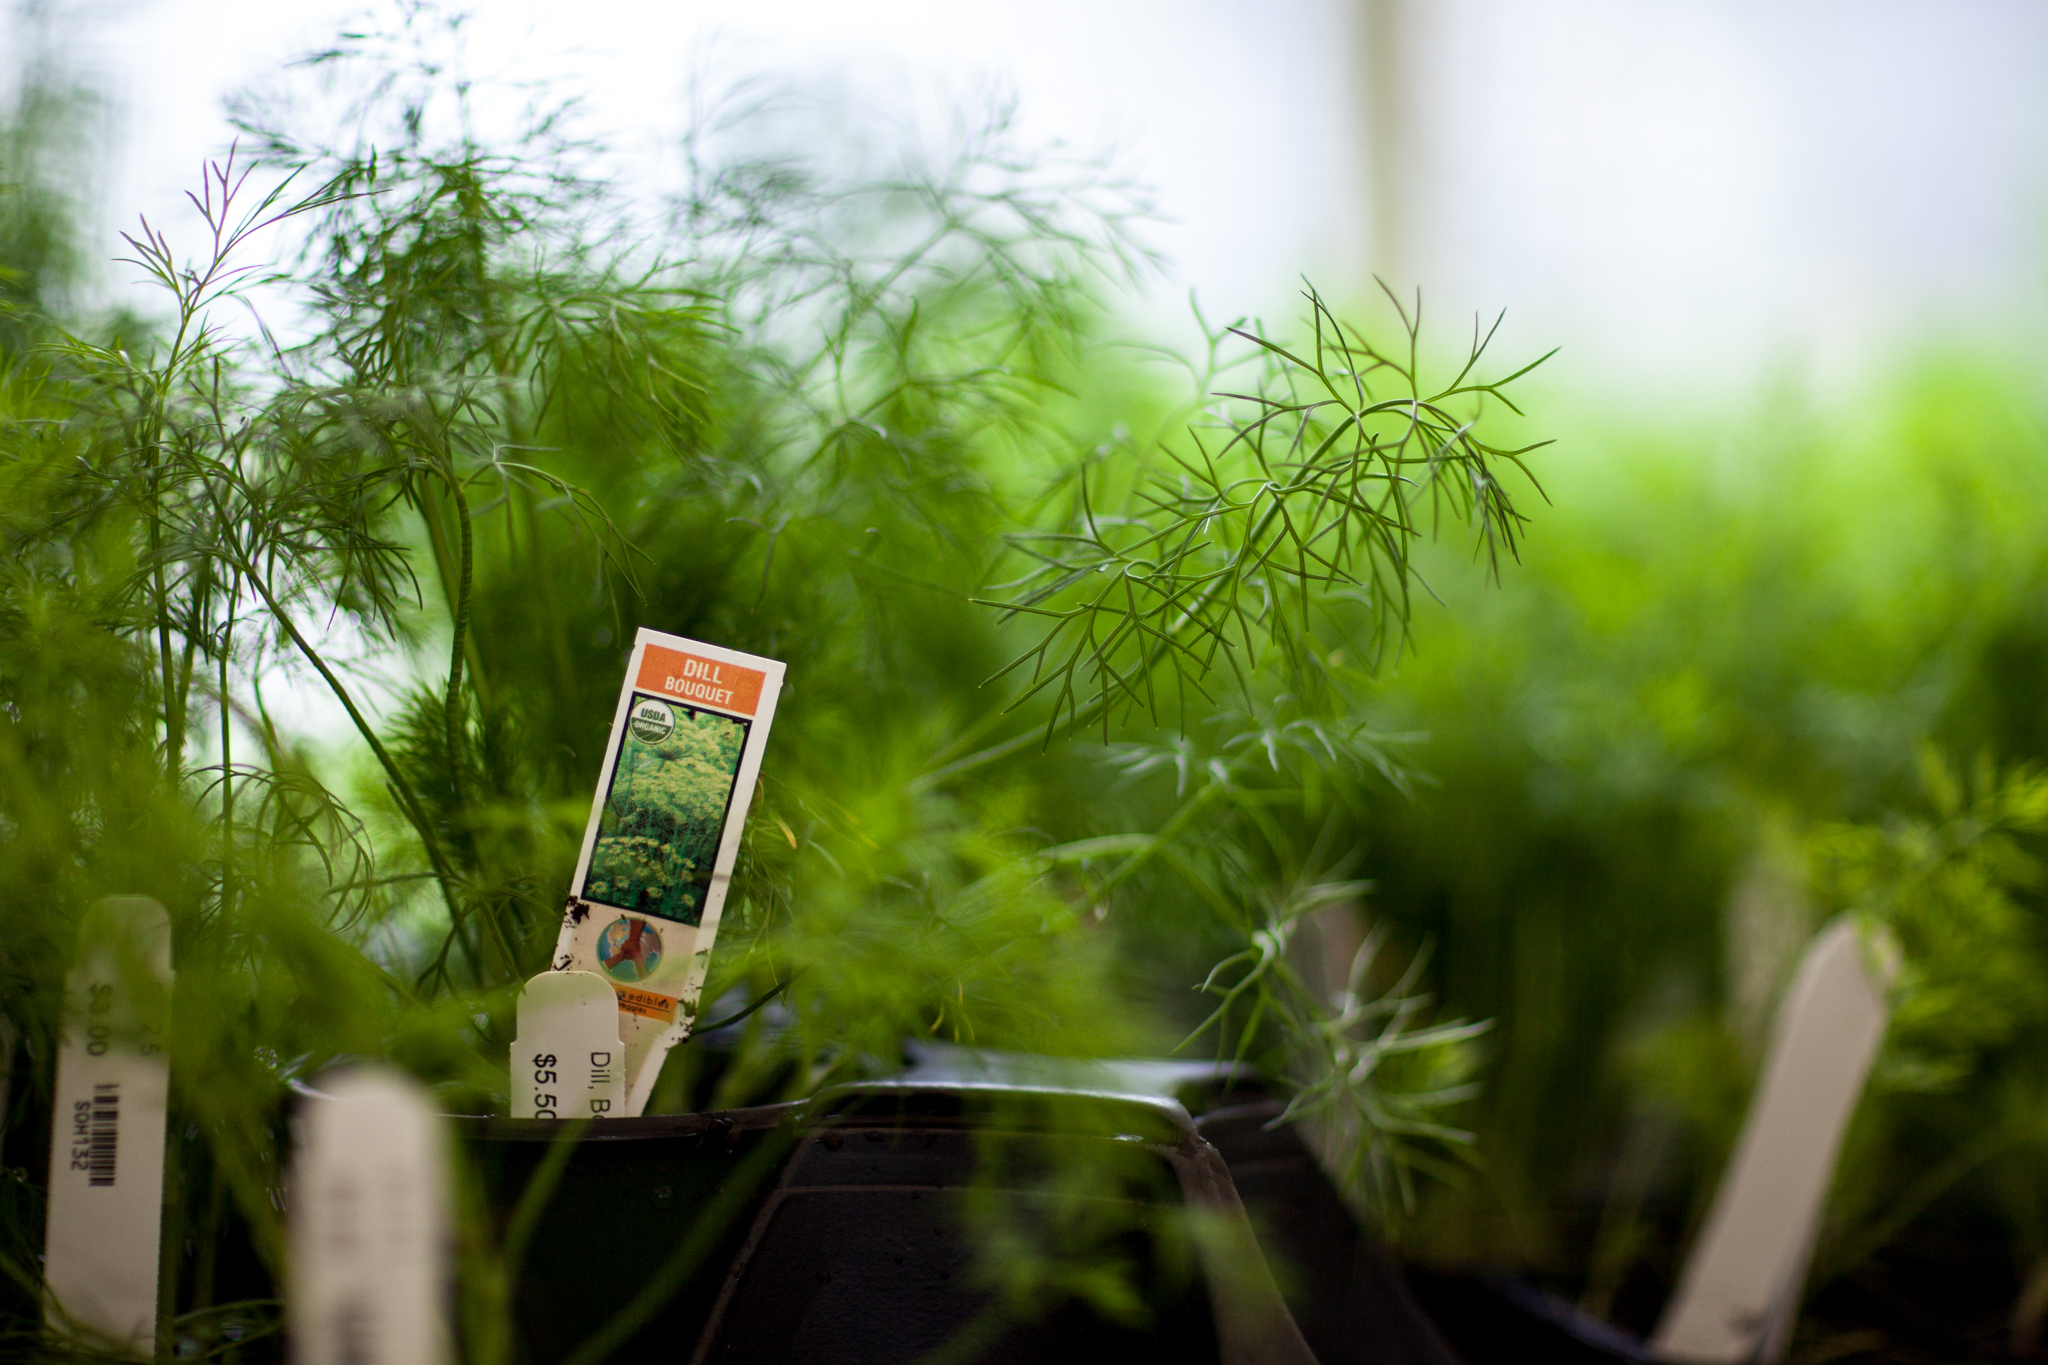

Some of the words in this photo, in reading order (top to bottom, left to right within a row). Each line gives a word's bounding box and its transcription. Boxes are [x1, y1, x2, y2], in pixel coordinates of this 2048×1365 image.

[683, 659, 722, 684] DILL
[664, 676, 734, 705] BOUQUET
[634, 720, 667, 735] ORGANIC
[640, 707, 666, 723] USDA
[629, 993, 670, 1009] edibles
[86, 984, 114, 1057] $300
[587, 1052, 611, 1089] Dill,
